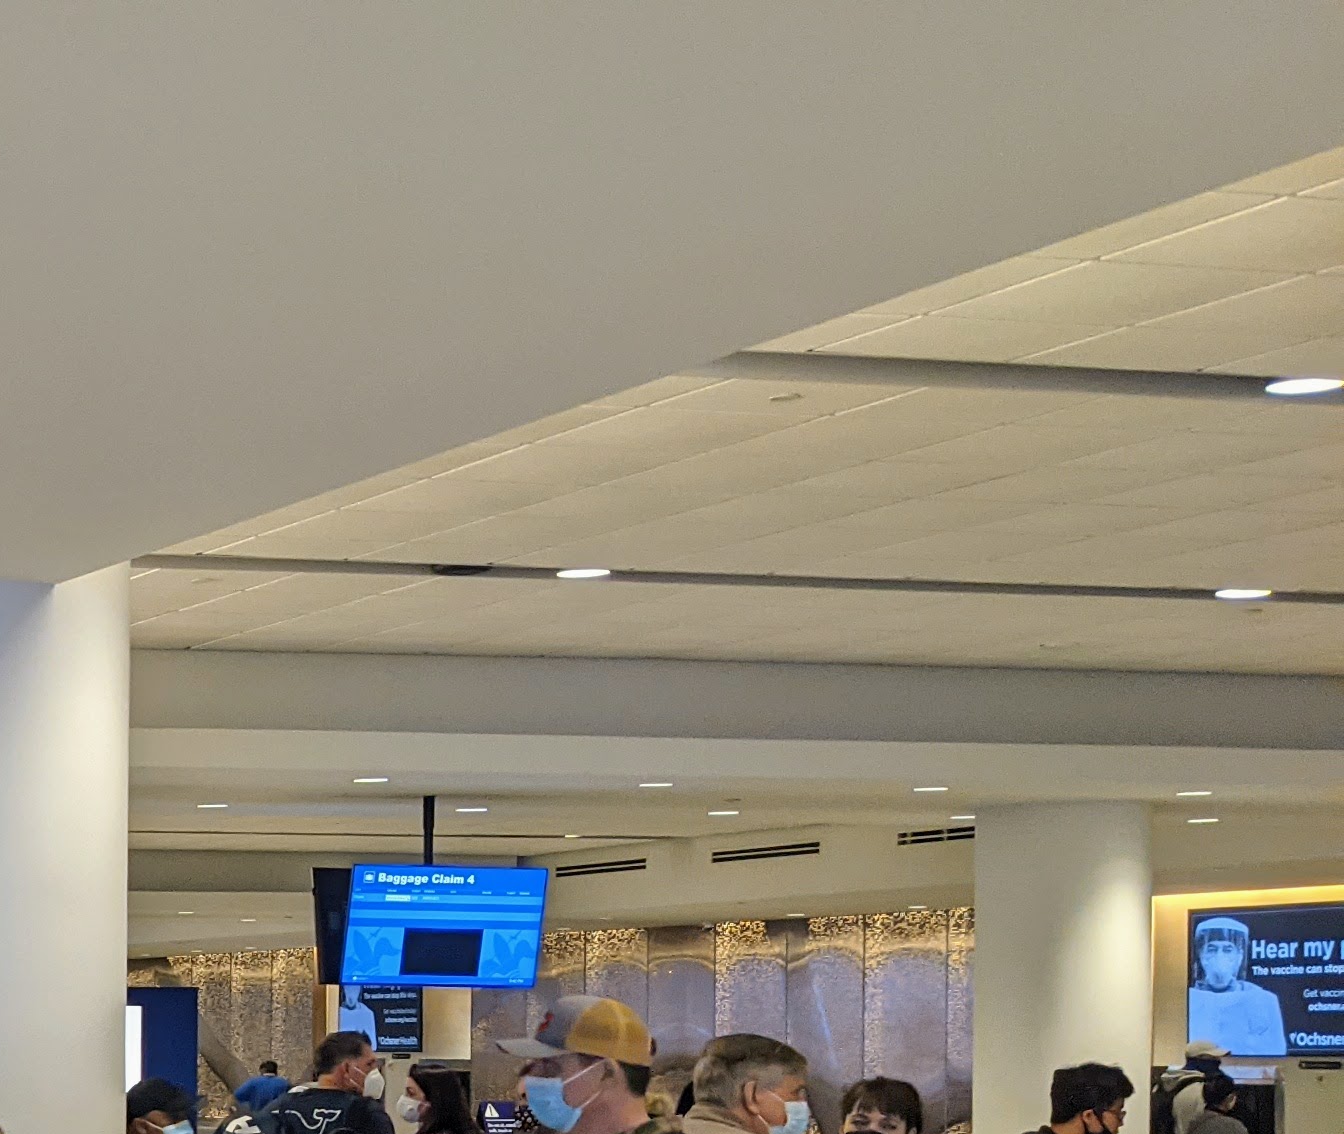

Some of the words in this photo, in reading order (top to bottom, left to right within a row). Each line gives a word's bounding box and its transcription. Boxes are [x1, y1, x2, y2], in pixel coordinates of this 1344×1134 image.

[378, 872, 429, 885] Baggage
[431, 874, 465, 884] Claim
[466, 875, 475, 884] 4
[1252, 940, 1298, 959] Hear
[1304, 940, 1335, 960] my
[1252, 965, 1269, 975] The
[1270, 965, 1304, 975] vaccine
[1305, 965, 1323, 974] can
[1303, 989, 1318, 998] Get
